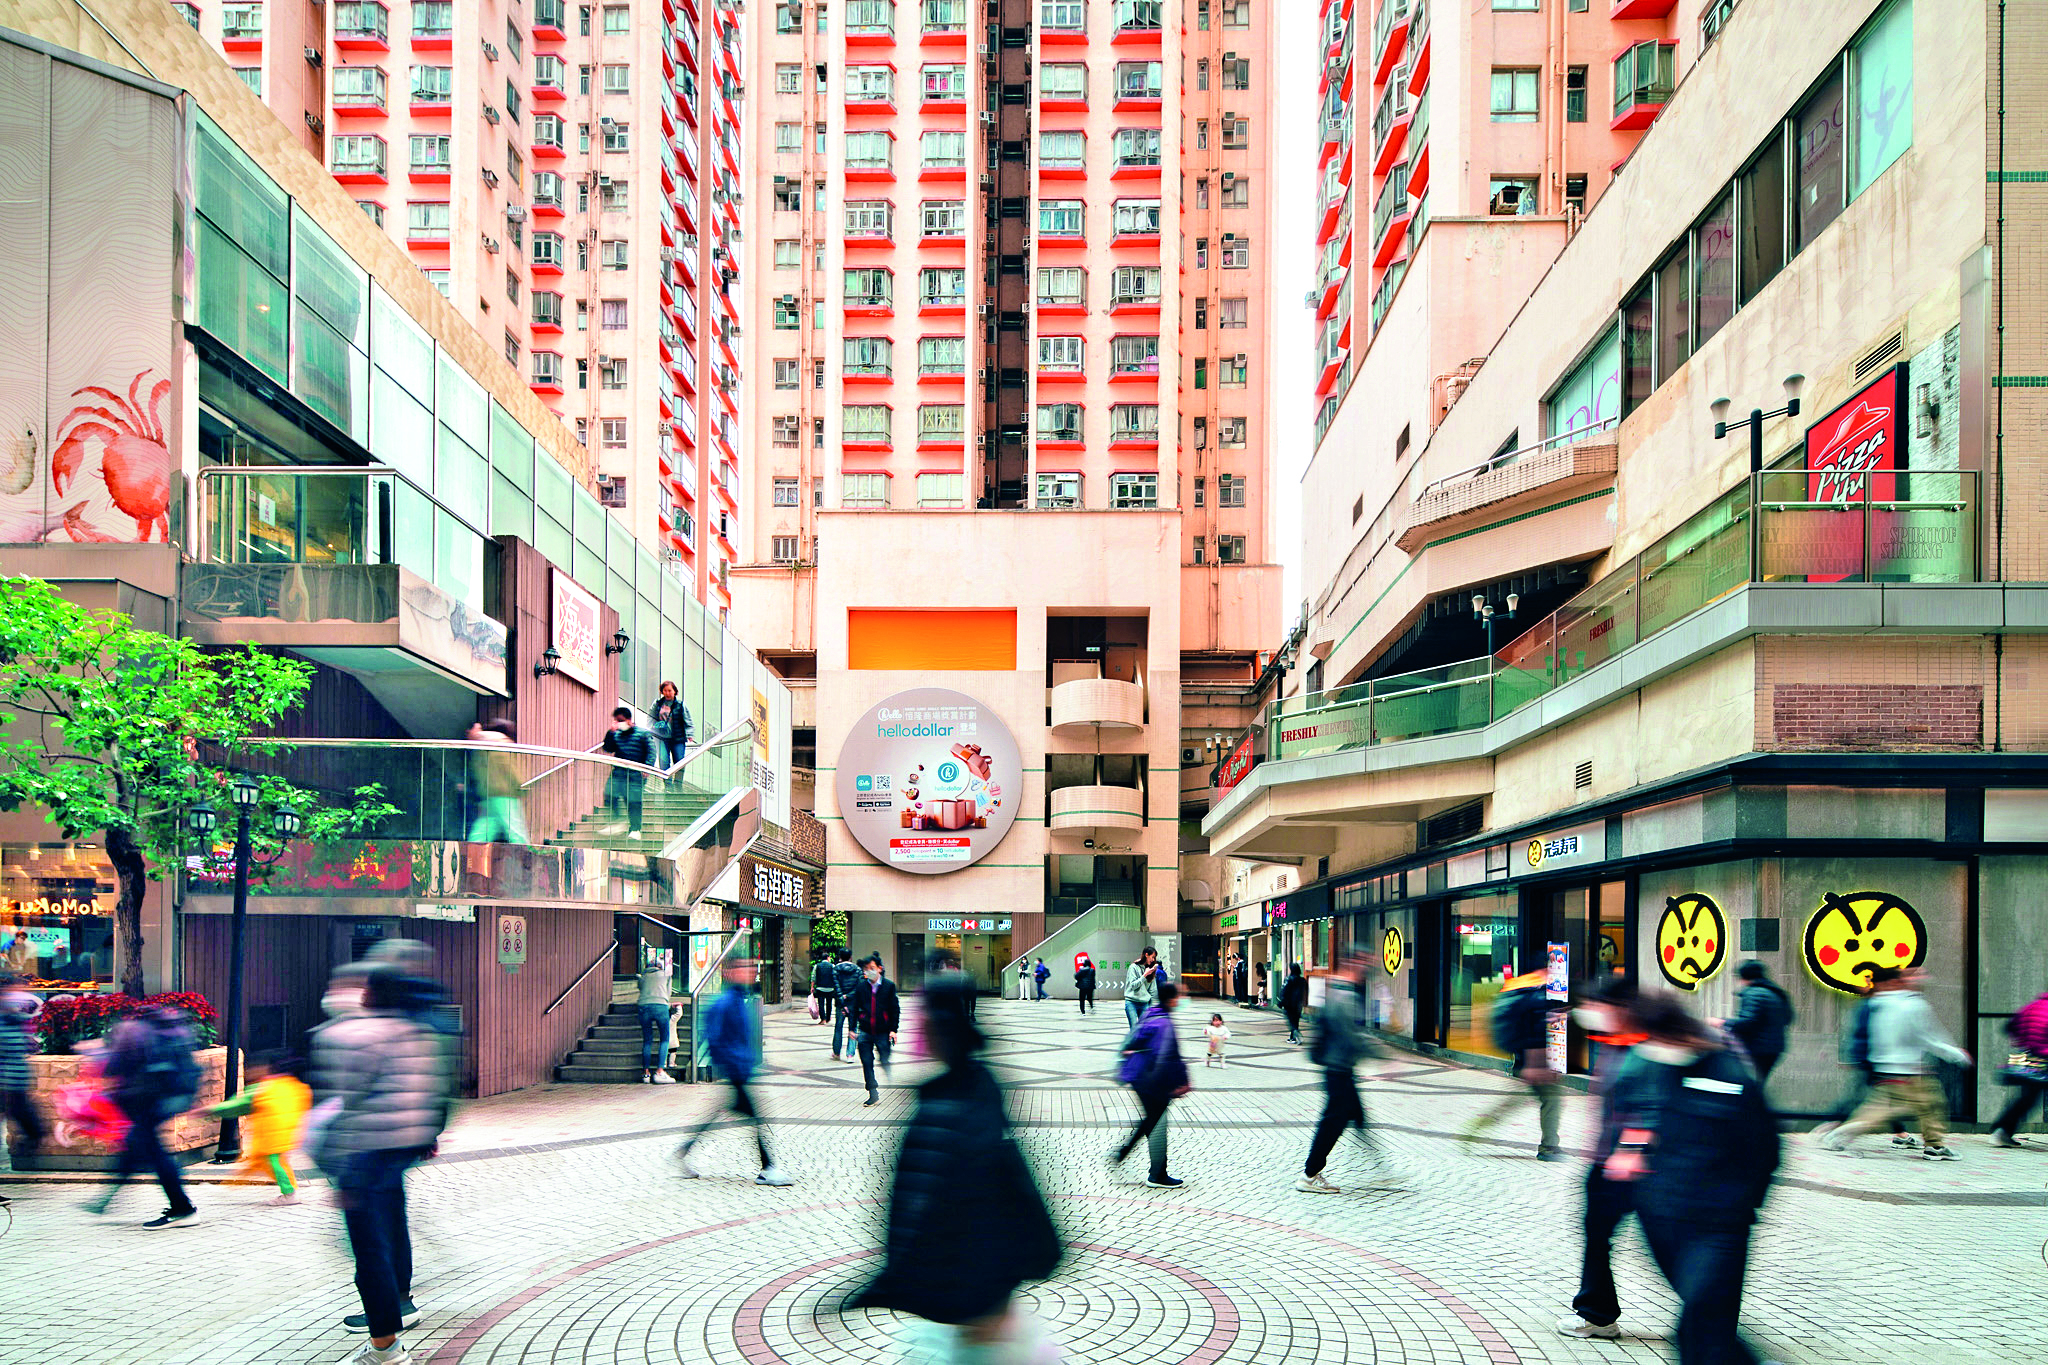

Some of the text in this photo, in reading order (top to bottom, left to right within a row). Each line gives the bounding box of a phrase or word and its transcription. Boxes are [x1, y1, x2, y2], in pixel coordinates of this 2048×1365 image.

[1815, 428, 1887, 502] Pizza
[1589, 615, 1615, 642] FRESHLY
[1281, 725, 1319, 743] FRESHLY
[753, 863, 804, 909] 海港酒家
[928, 919, 961, 931] HSBC
